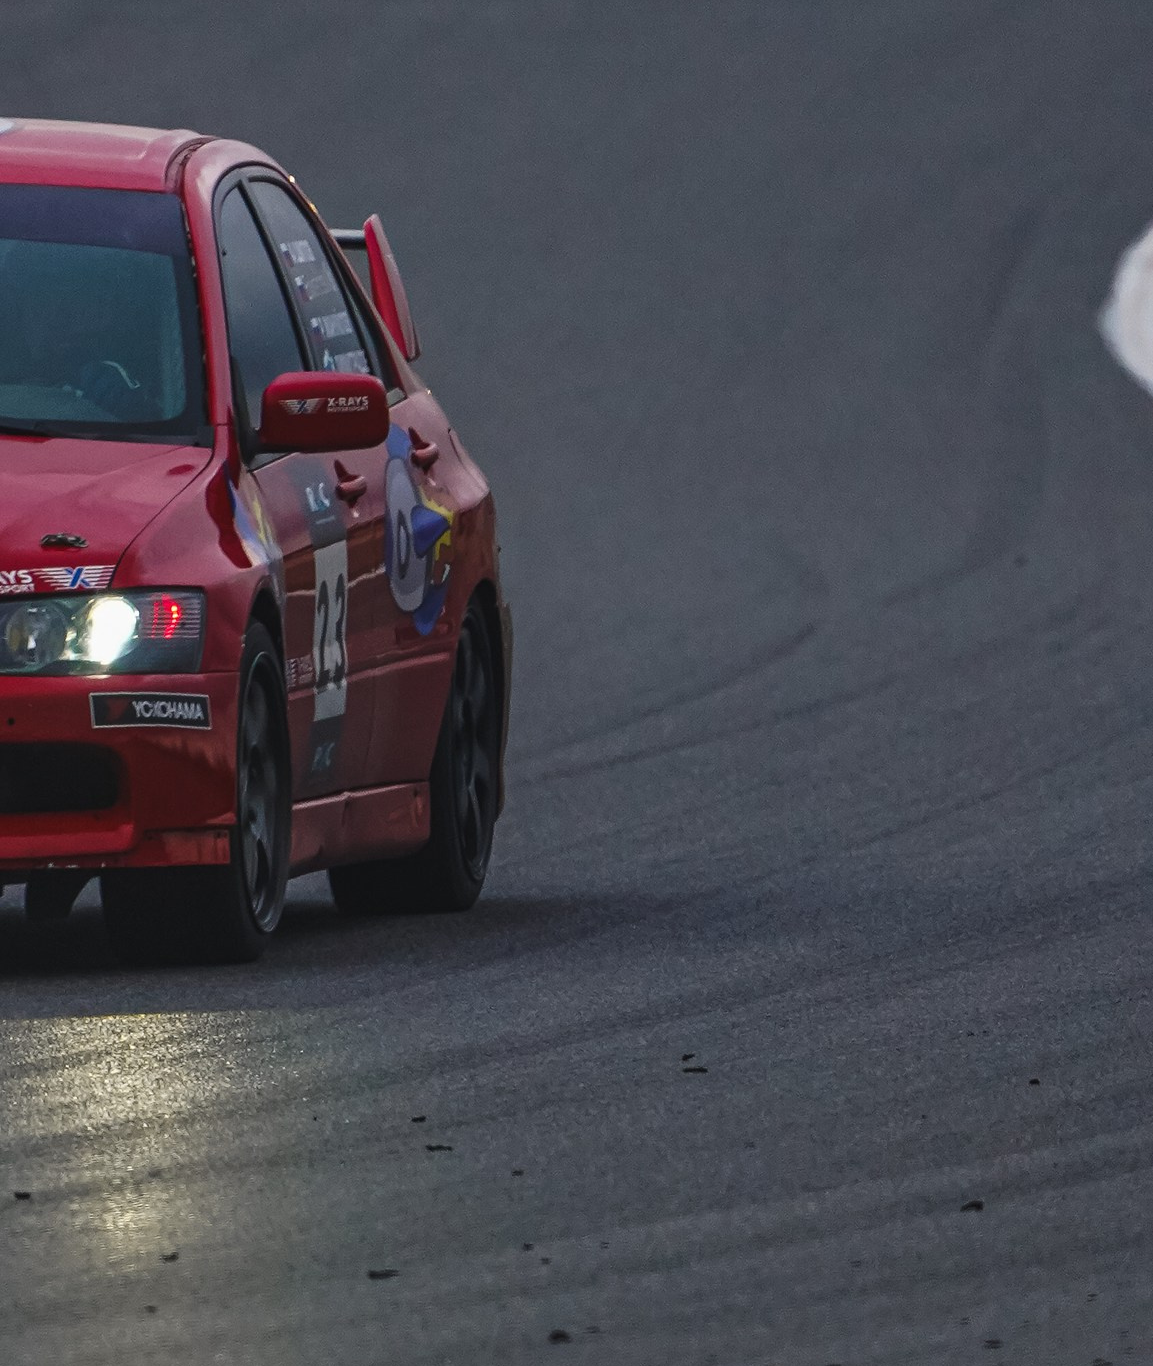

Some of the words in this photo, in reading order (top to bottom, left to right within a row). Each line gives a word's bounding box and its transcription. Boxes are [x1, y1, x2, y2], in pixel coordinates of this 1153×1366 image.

[328, 396, 369, 407] X-RAYS
[315, 573, 346, 695] 23
[132, 700, 205, 721] YOKOHAMA
